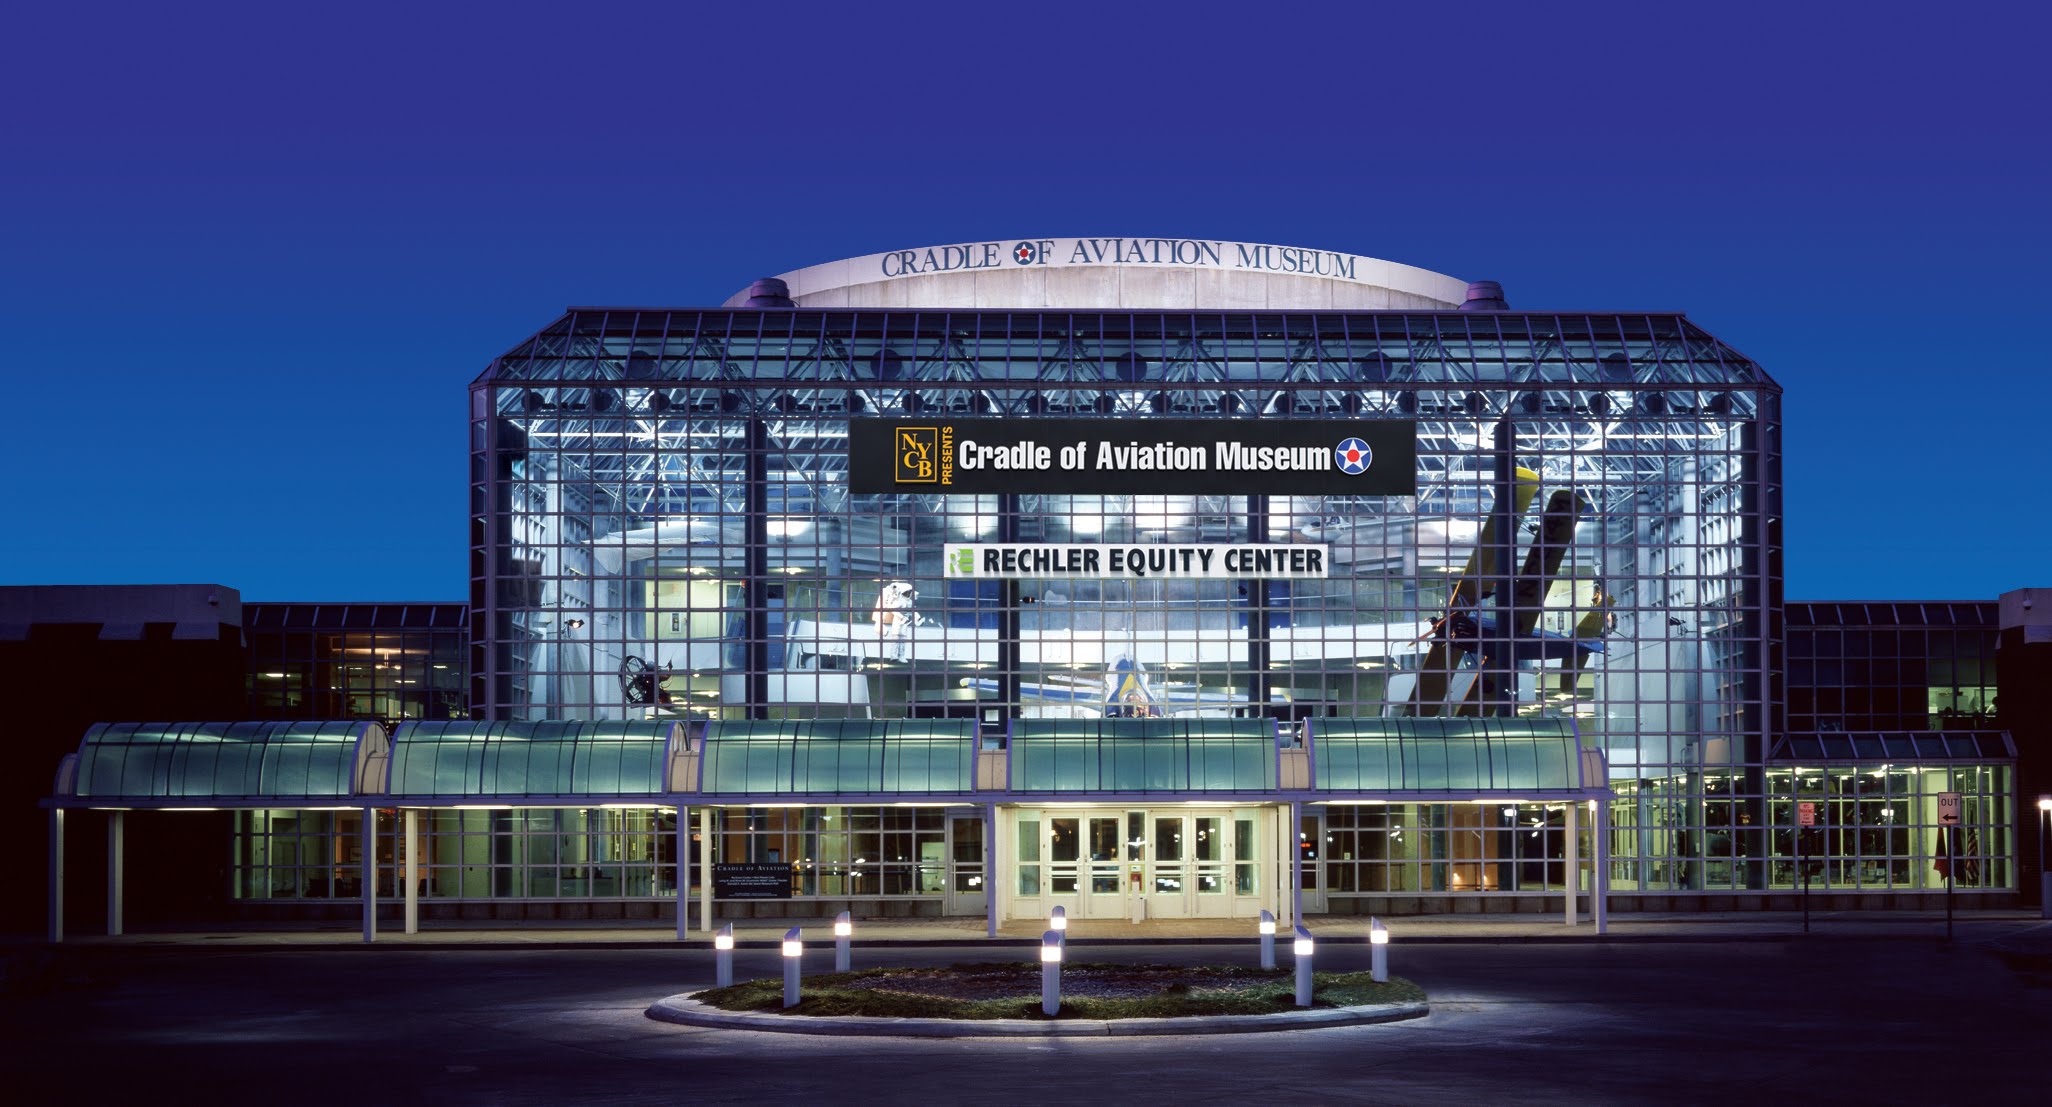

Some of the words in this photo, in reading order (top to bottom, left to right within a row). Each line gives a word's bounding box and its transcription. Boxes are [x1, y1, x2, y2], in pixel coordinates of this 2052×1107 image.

[881, 242, 1000, 277] CRADLE
[1069, 238, 1222, 266] AVIATION
[1236, 244, 1357, 280] MUSEUM
[941, 426, 954, 485] PRESENTS
[959, 440, 1050, 470] Cradle
[1060, 441, 1087, 470] of
[1096, 441, 1206, 470] Aviation
[1215, 441, 1331, 470] Museum
[983, 548, 1100, 572] RECHLER
[1109, 548, 1214, 577] EQUITY
[1224, 548, 1323, 572] CENTER
[1940, 798, 1958, 807] OUT
